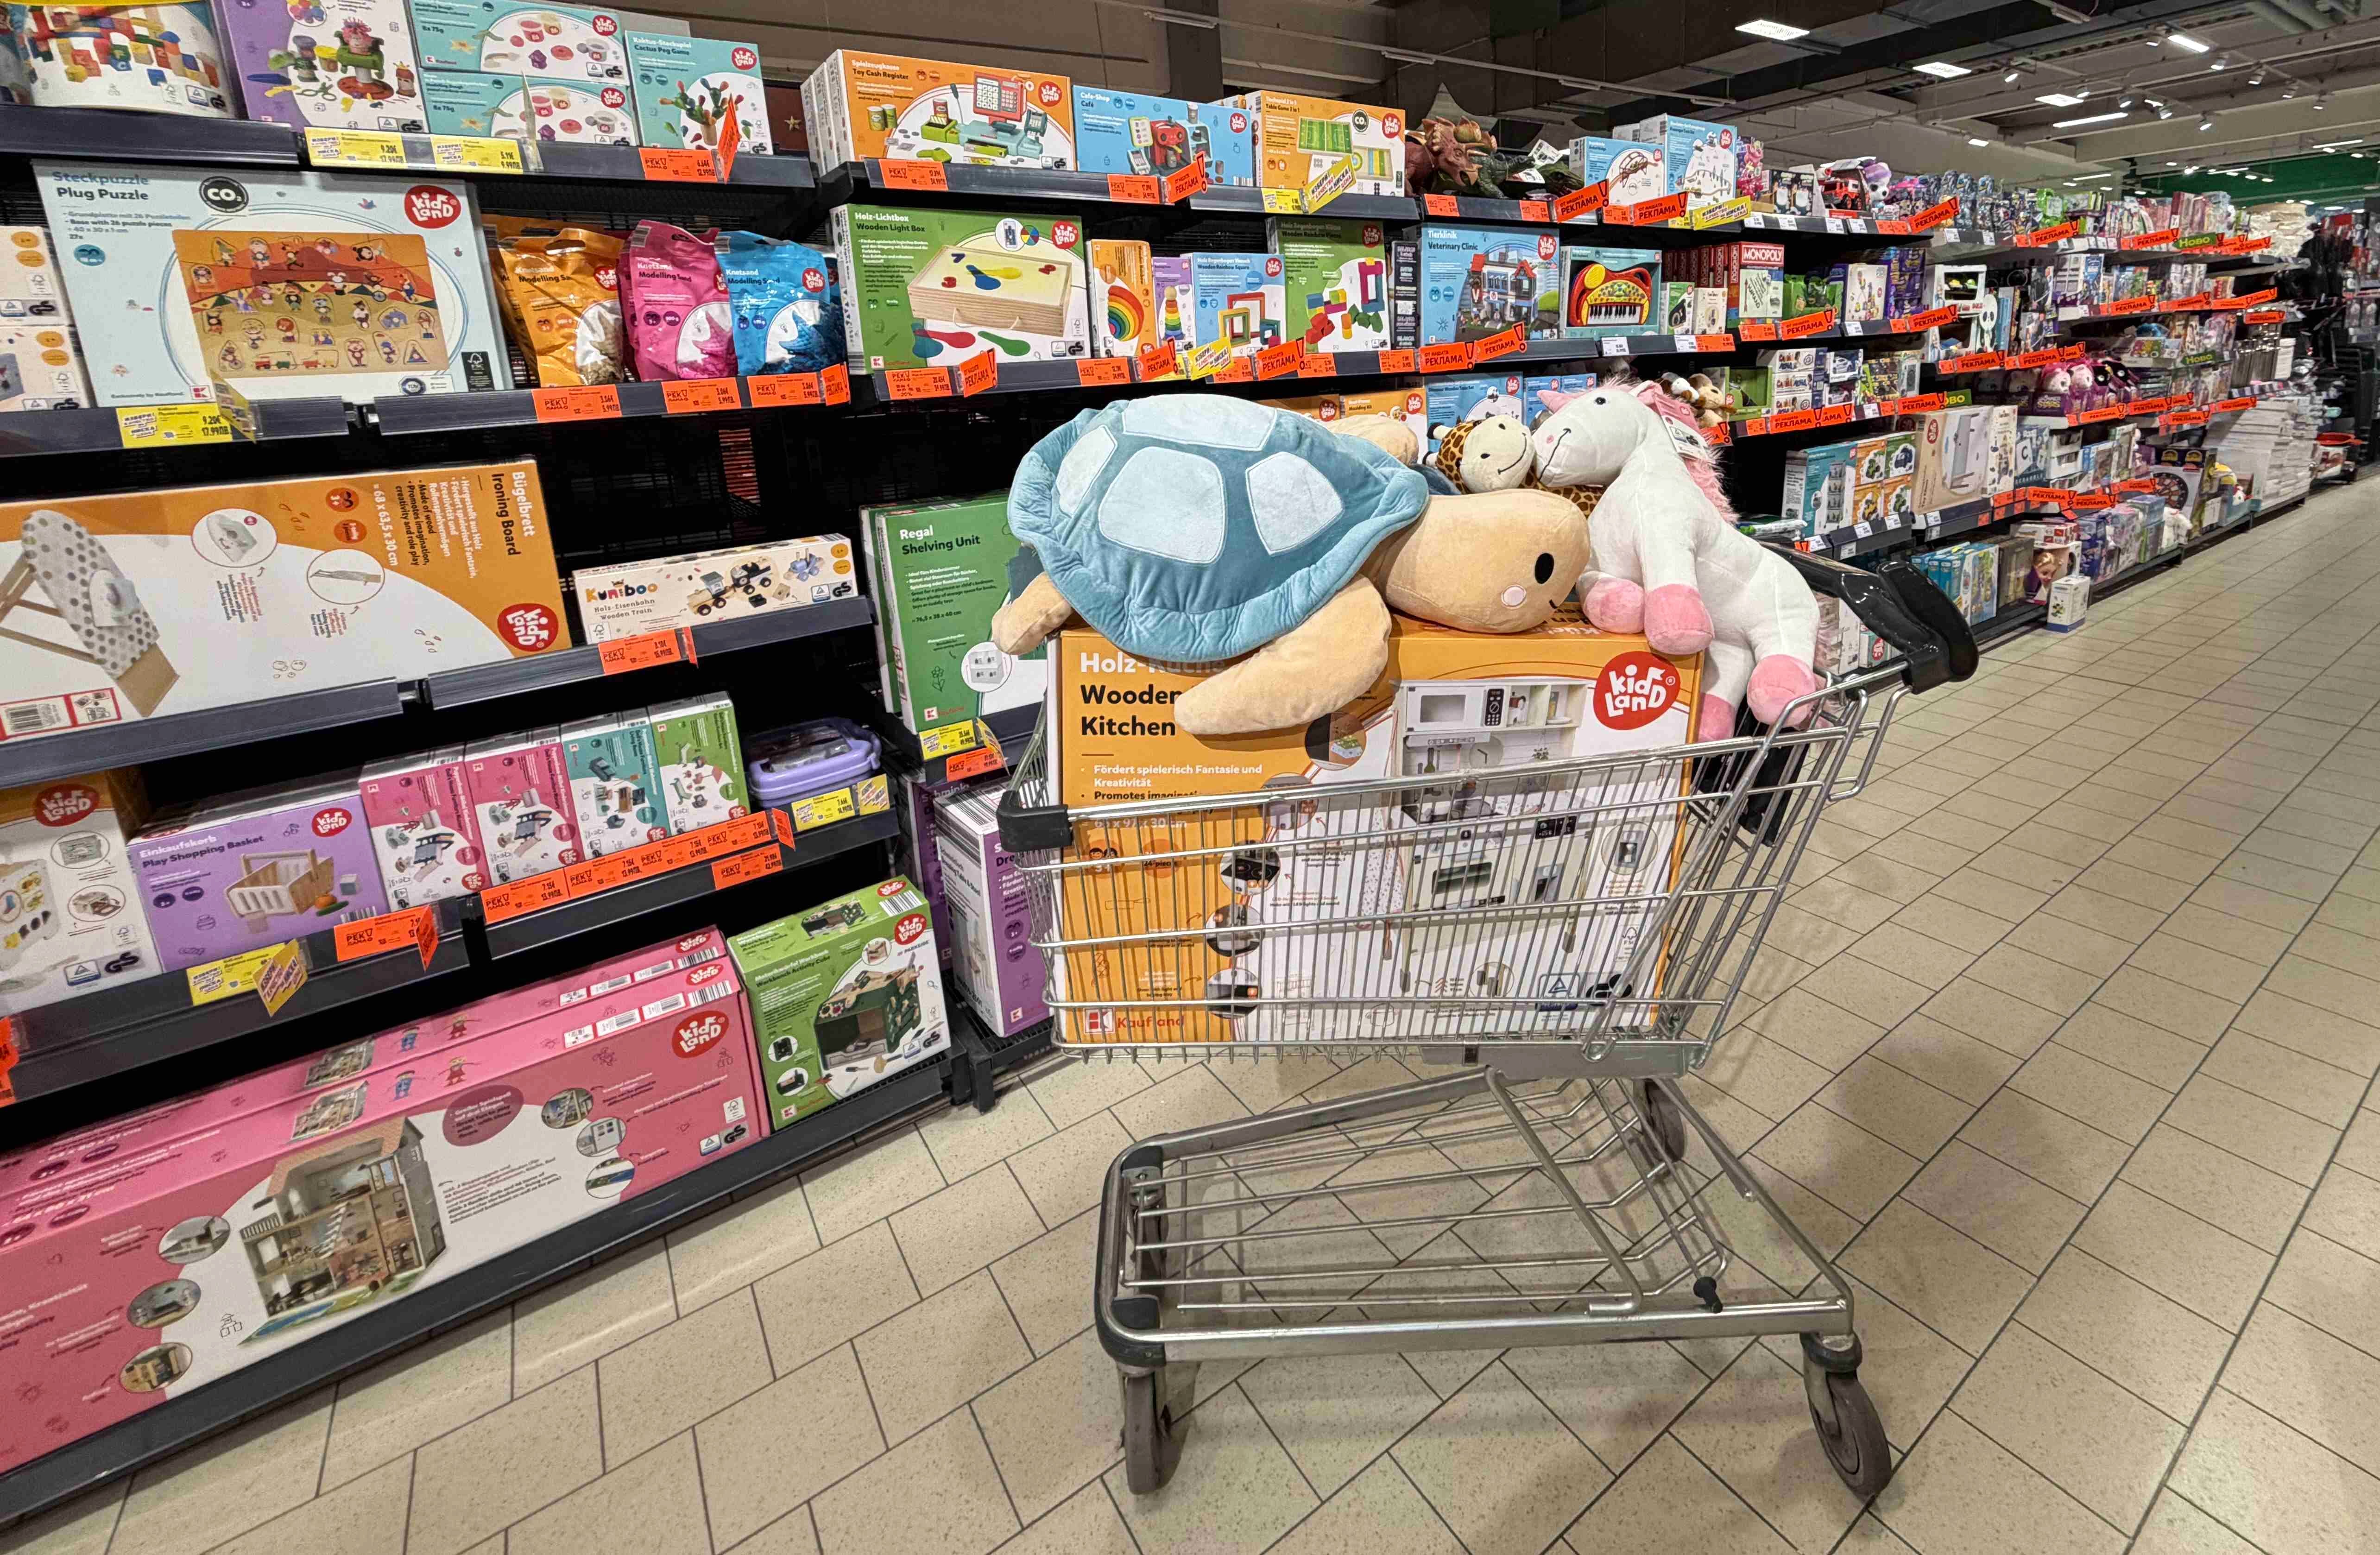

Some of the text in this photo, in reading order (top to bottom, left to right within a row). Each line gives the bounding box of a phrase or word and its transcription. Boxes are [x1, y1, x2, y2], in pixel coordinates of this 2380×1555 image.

[852, 68, 909, 80] Toy Cash Register
[53, 171, 149, 186] Steckpuzzle
[57, 187, 149, 201] Plug Puzzle
[1561, 195, 1599, 215] РЕКЛАМА
[1639, 205, 1676, 219] РЕКЛАМА
[855, 212, 909, 222] Holz-Lichtbox
[1915, 209, 1950, 228] РЕКЛАМА
[890, 223, 910, 232] Light
[1427, 230, 1457, 240] Tierklinik
[2036, 229, 2070, 242] РЕКЛАМА
[2137, 234, 2170, 246] РЕКЛАМА
[1428, 242, 1460, 251] Veterinary
[1743, 248, 1783, 262] MONOPOLY
[518, 275, 560, 283] Modelling
[639, 272, 676, 281] Modelling
[2115, 302, 2147, 311] РЕКЛАМА
[1914, 314, 1949, 327] РЕКЛАМА
[1787, 321, 1824, 335] РЕКЛАМА
[1485, 340, 1515, 354] РЕКЛАМА
[1263, 354, 1296, 371] РЕКЛАМА
[1425, 354, 1464, 367] РЕКЛАМА
[1962, 358, 1996, 369] РЕКЛАМА
[2023, 354, 2057, 365] РЕКЛАМА
[1902, 400, 1937, 411] РЕКЛАМА
[1775, 417, 1812, 429] РЕКЛАМА
[374, 491, 386, 503] 68
[511, 471, 535, 537] Bügelbrett
[418, 484, 437, 534] Made of wood
[492, 473, 521, 556] Ironing Board
[378, 511, 393, 531] 63,5
[396, 486, 420, 566] creativity and role play
[407, 485, 430, 565] Promotes imagination,
[448, 521, 459, 535] und
[899, 524, 934, 540] Regal
[385, 539, 397, 551] 30
[902, 535, 981, 555] Shelving Unit
[388, 552, 398, 566] cm
[585, 582, 658, 603] Kuniboo
[594, 598, 656, 613] Holz-Eisenbahn
[600, 612, 630, 620] Wooden
[1608, 664, 1666, 695] kid
[1081, 715, 1176, 737] Kitchen
[1093, 764, 1262, 776] Fördert spielerisch Fantasie und
[1093, 778, 1152, 787] Kreativität
[1094, 791, 1146, 800] Promotes
[139, 835, 218, 858] Einkaufskorb
[142, 835, 265, 868] Play Shopping Basket
[757, 955, 831, 987] Workbench Activity Cube
[1117, 1016, 1185, 1029] Kaufand
